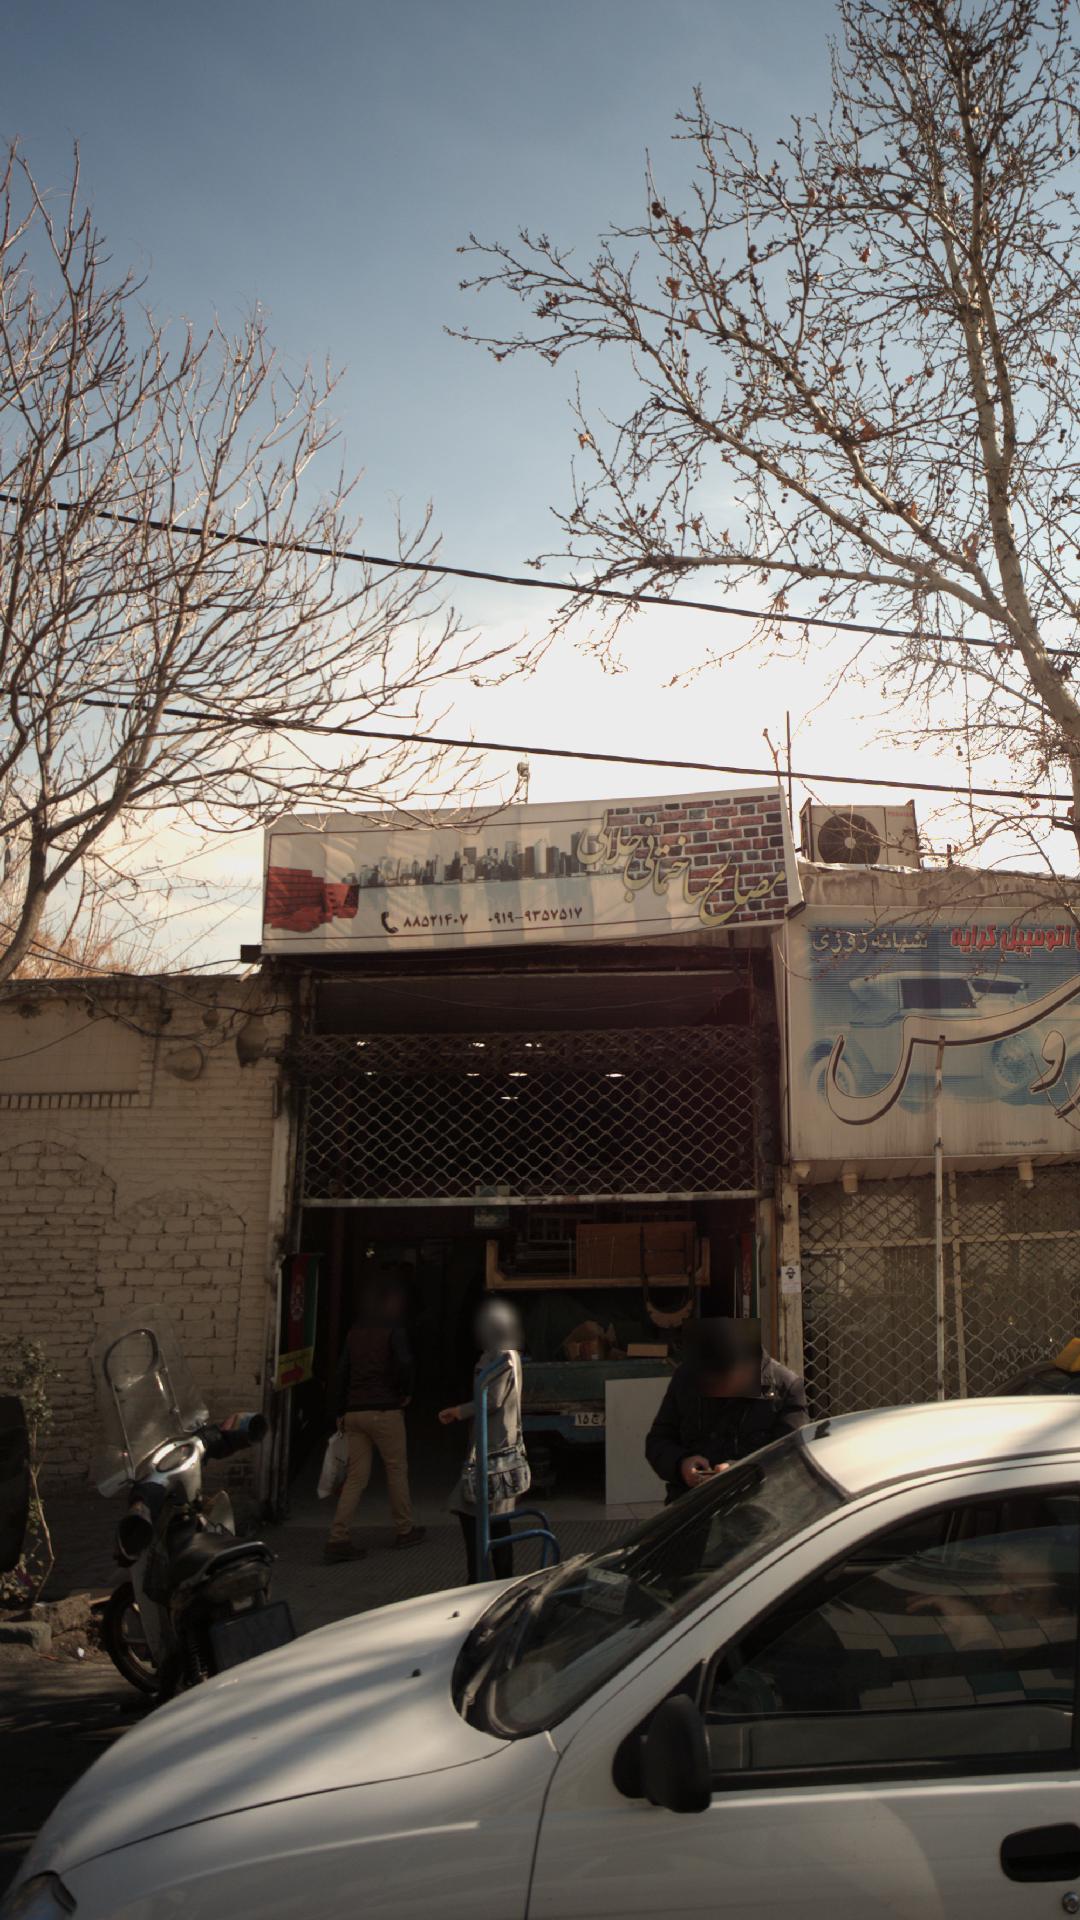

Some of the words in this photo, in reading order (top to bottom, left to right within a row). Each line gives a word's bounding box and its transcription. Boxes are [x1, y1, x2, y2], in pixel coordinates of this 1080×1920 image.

[623, 816, 713, 905] ساختمانی
[700, 854, 786, 926] مصالح
[403, 913, 469, 928] ۸۸۵۲۱۴۰۷
[871, 930, 928, 953] شبانه
[950, 924, 997, 953] کرایه
[1000, 924, 1072, 958] اتومبیل
